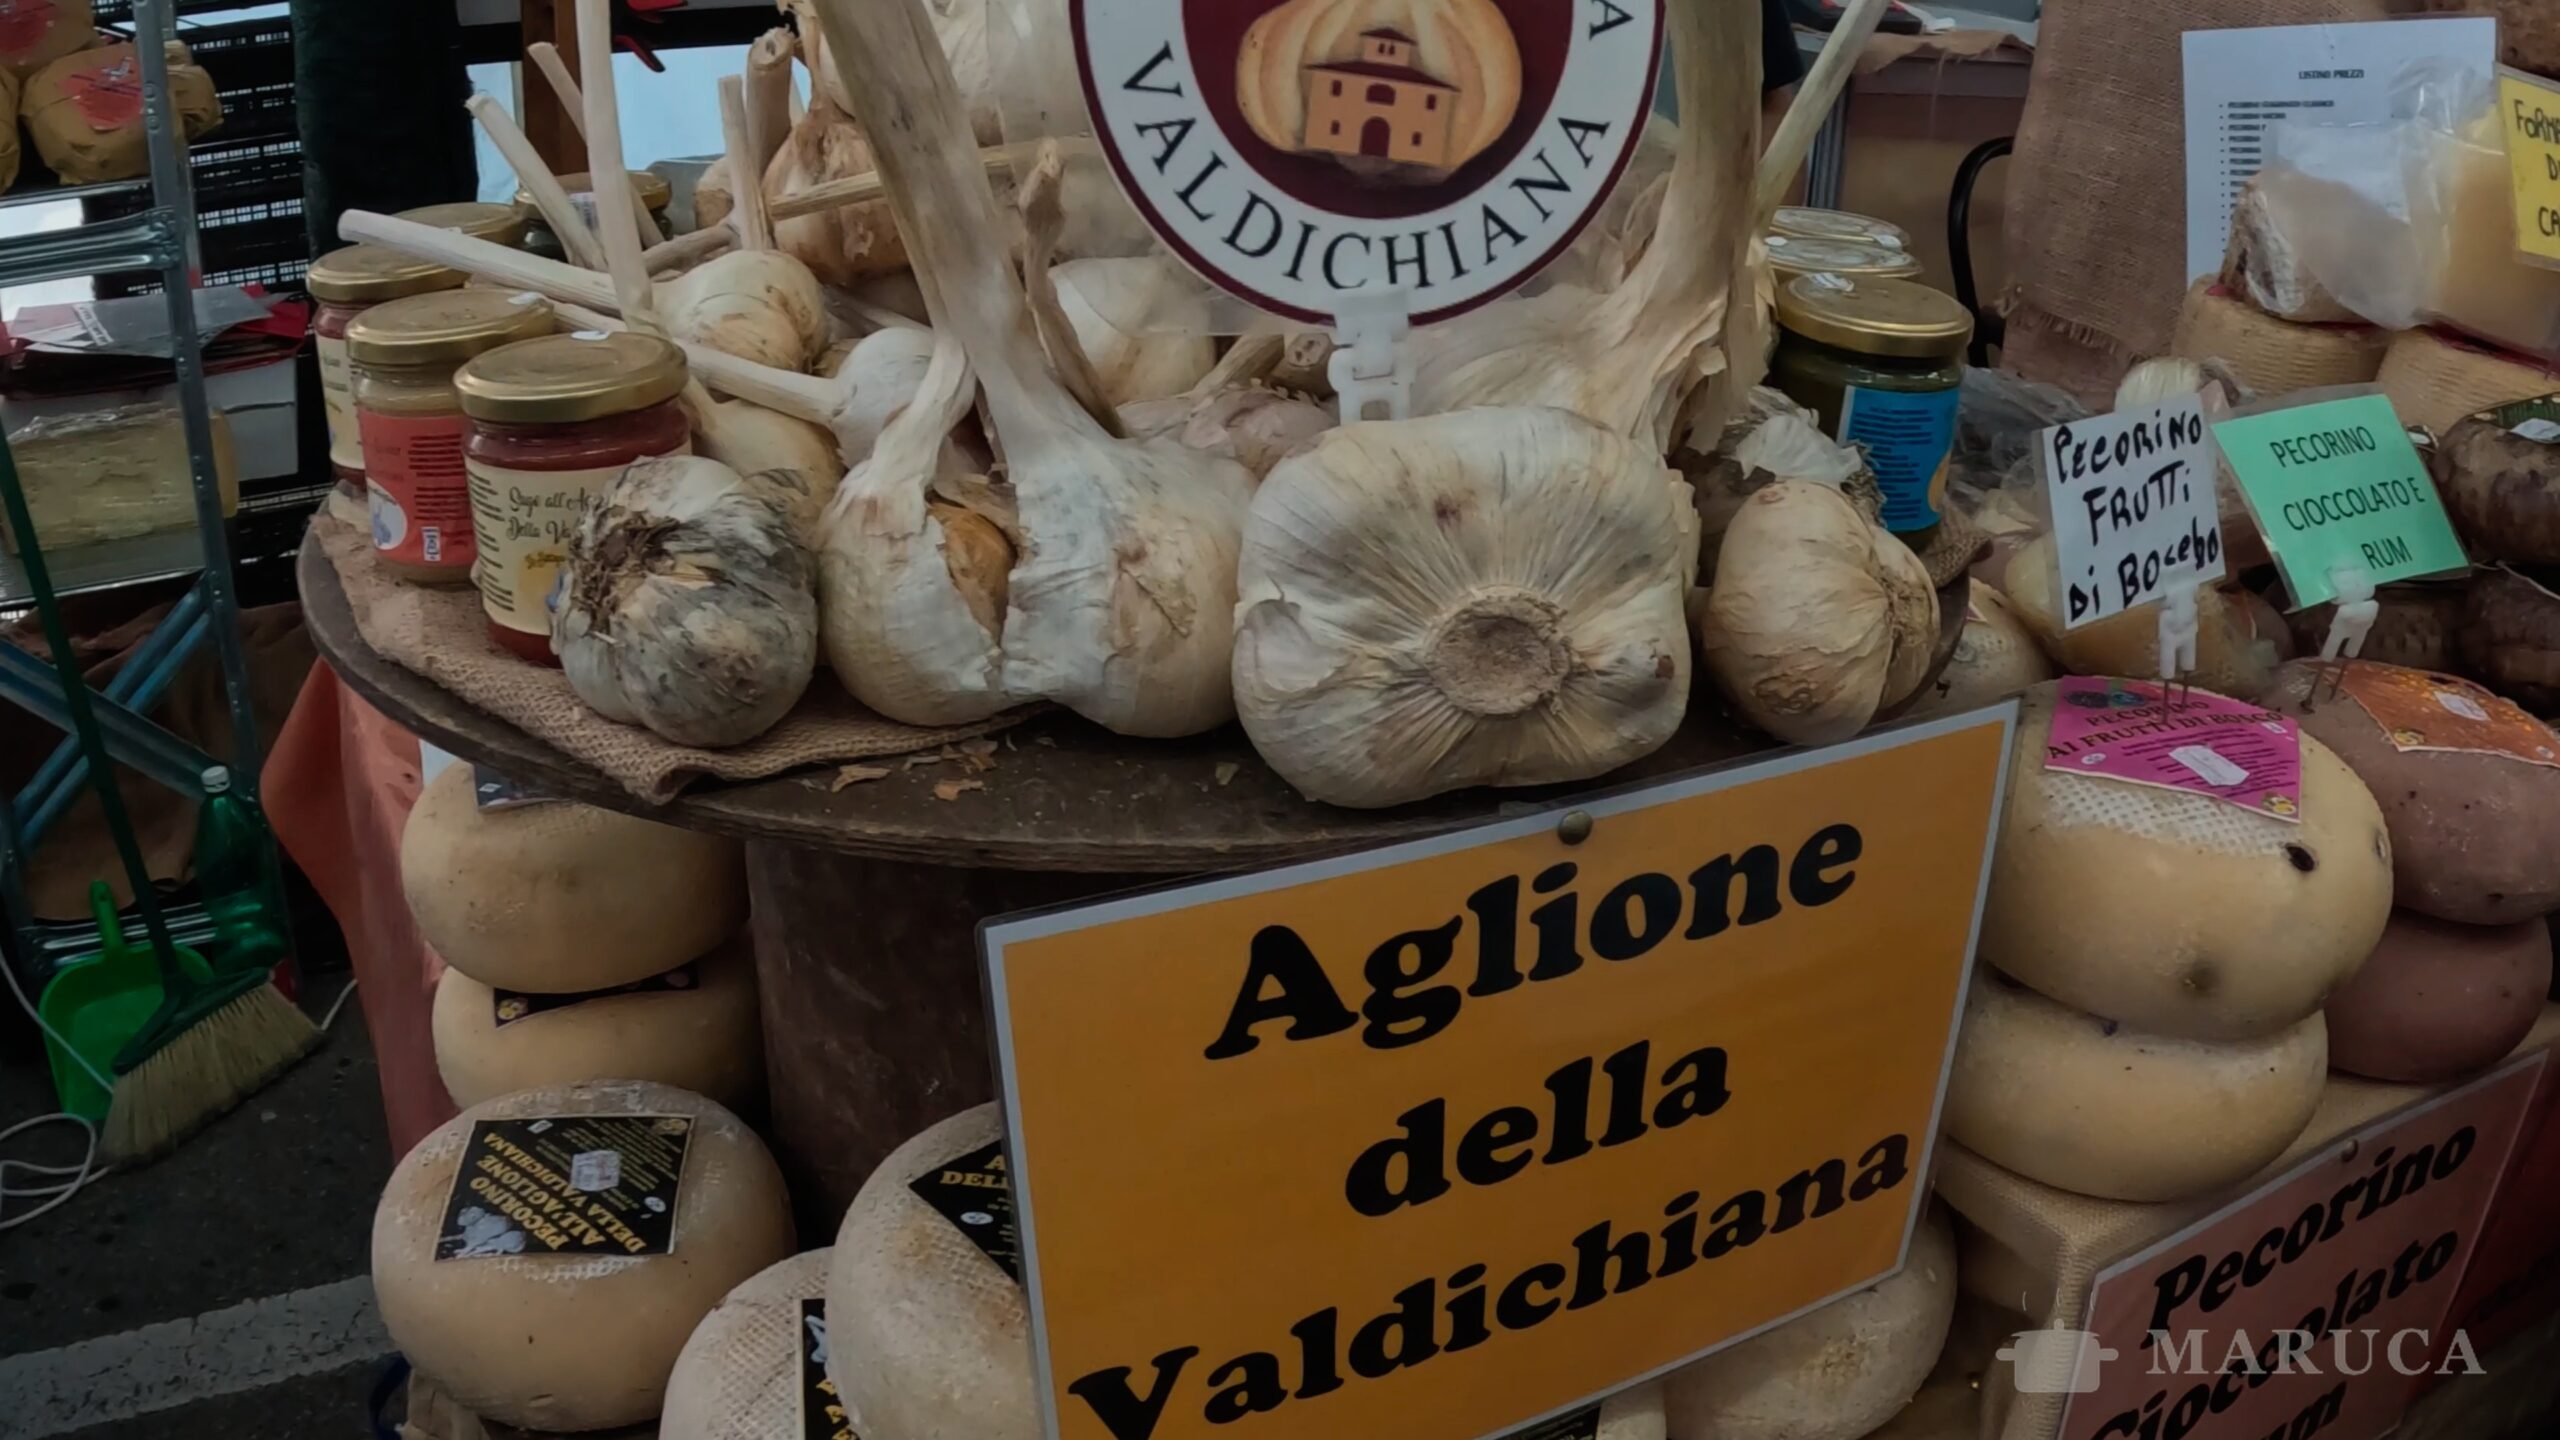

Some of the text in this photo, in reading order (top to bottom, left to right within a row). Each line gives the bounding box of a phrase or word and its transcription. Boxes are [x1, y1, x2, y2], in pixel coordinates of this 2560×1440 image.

[1122, 40, 1612, 290] VALDICHIANA
[2269, 425, 2377, 468] PECORINO
[2283, 476, 2426, 531] CIOCCOLATO E
[2360, 534, 2414, 571] RUM
[1203, 823, 1863, 1061] Aglione
[482, 1131, 589, 1208] VALDICHIANA
[1344, 1039, 1732, 1218] della
[469, 1176, 571, 1251] PECORINO
[475, 1153, 607, 1247] ALL'AGLIONE
[587, 1202, 648, 1254] DELLA
[2140, 1125, 2477, 1350] Pecorino
[1067, 1133, 1910, 1440] Valdichiana
